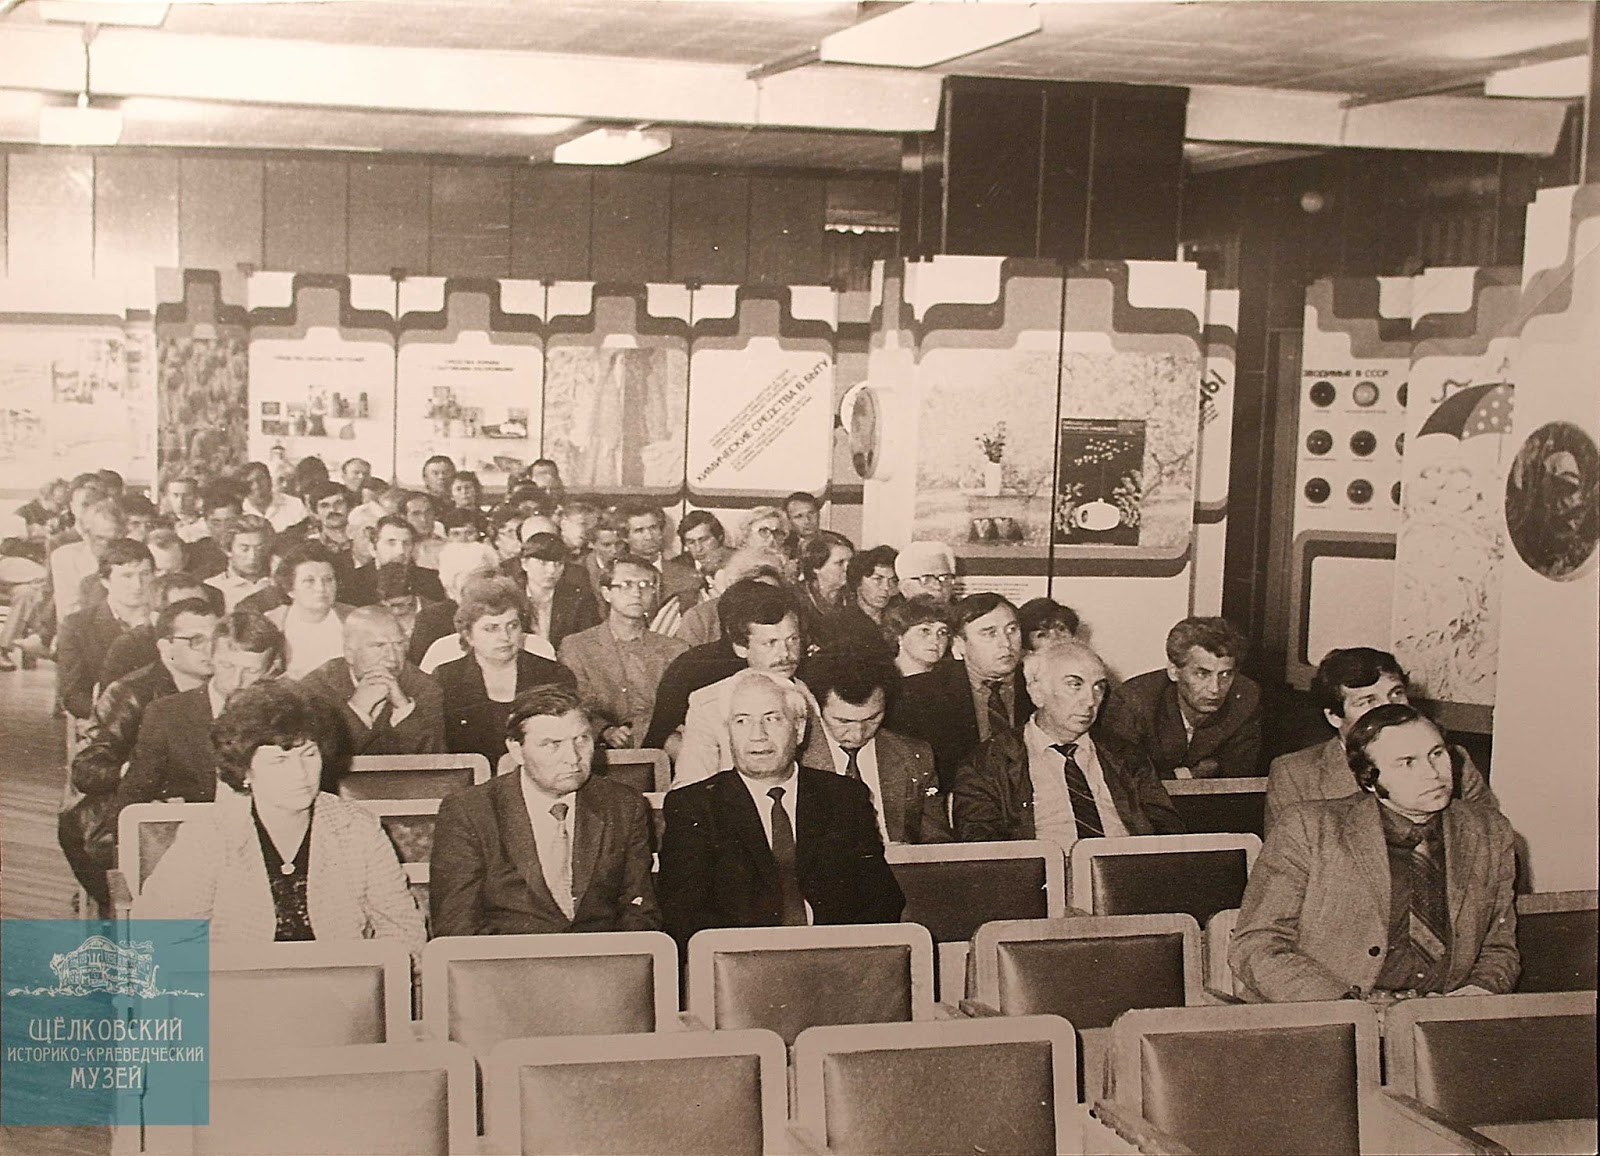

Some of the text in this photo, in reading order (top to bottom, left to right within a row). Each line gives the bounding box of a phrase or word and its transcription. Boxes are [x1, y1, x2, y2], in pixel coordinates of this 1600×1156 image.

[1365, 369, 1388, 377] СССР
[696, 430, 752, 482] ХИМИЧЕСКИЕ
[751, 389, 798, 432] СРЕДСТВА
[795, 381, 805, 391] В
[803, 359, 829, 384] БЫТУ
